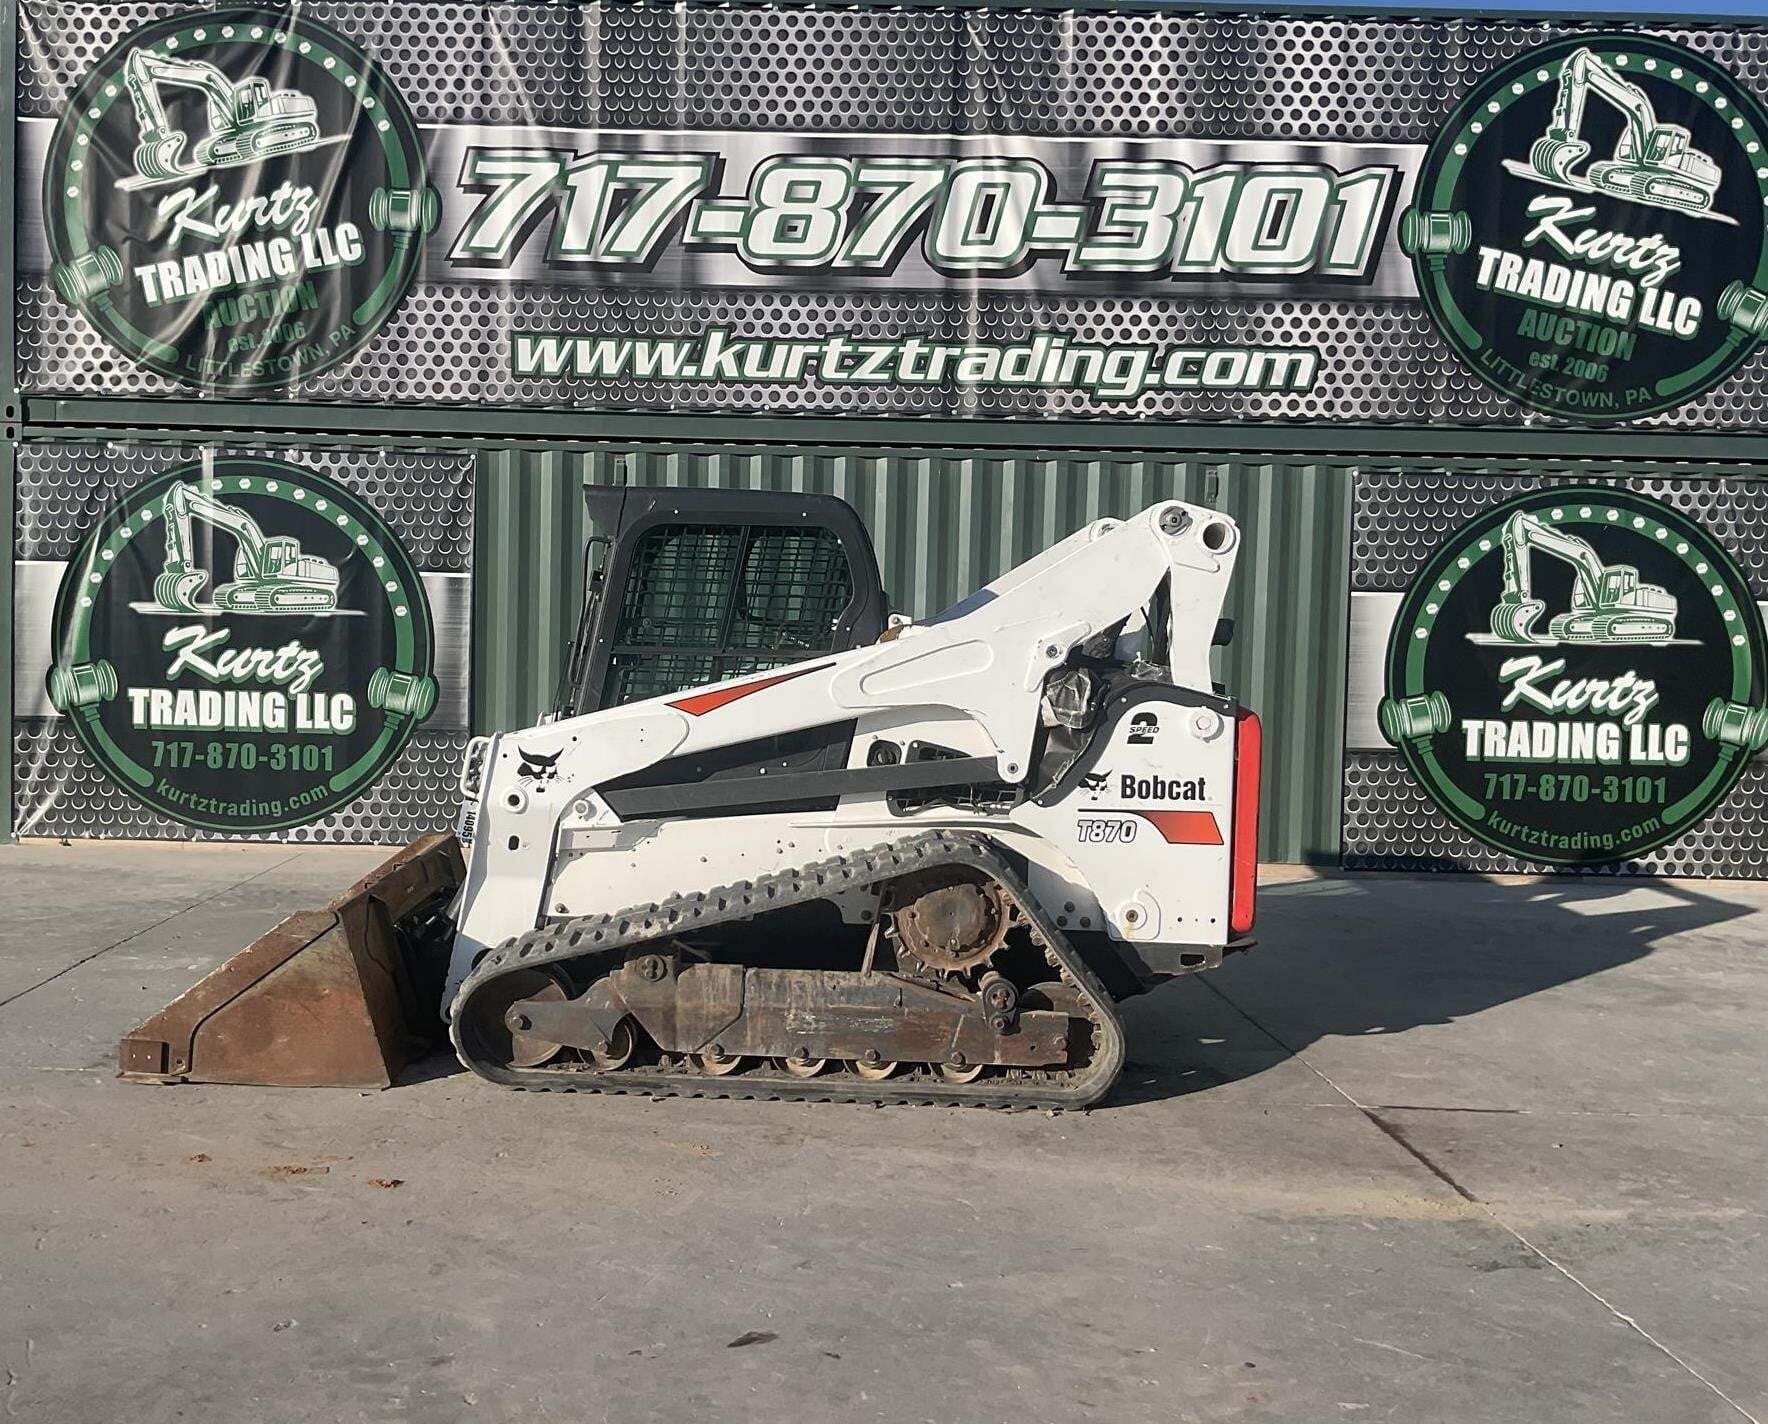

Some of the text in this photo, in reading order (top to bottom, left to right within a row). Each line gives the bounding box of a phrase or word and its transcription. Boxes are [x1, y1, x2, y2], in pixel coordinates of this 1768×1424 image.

[158, 181, 321, 247] Kurtz
[449, 147, 1403, 283] 717-870-3101
[134, 222, 365, 306] TRADING LLC
[1524, 195, 1681, 287] Kurtz
[203, 281, 320, 330] AUCTION
[1477, 246, 1703, 337] TRADING LLC
[329, 324, 356, 347] PA
[1517, 308, 1639, 361] AUCTION
[510, 323, 1321, 399] www.kurtztrading.com
[1480, 348, 1651, 408] LITTLESTOWN, PA
[1562, 357, 1609, 383] 2006
[162, 625, 323, 693] Kurtz
[127, 688, 356, 734] TRADING LLC
[1499, 655, 1659, 724] Kurtz
[1127, 712, 1159, 744] 2
[1128, 726, 1160, 734] SPEED
[1462, 720, 1690, 766] TRADING LLC
[152, 741, 333, 771] 717-870-3101
[155, 778, 330, 817] kurtztrading.com
[1121, 774, 1206, 801] Bobcat
[1484, 772, 1666, 804] 717-870-3101
[1077, 819, 1138, 844] T870
[1487, 811, 1661, 849] kurtztrading.com
